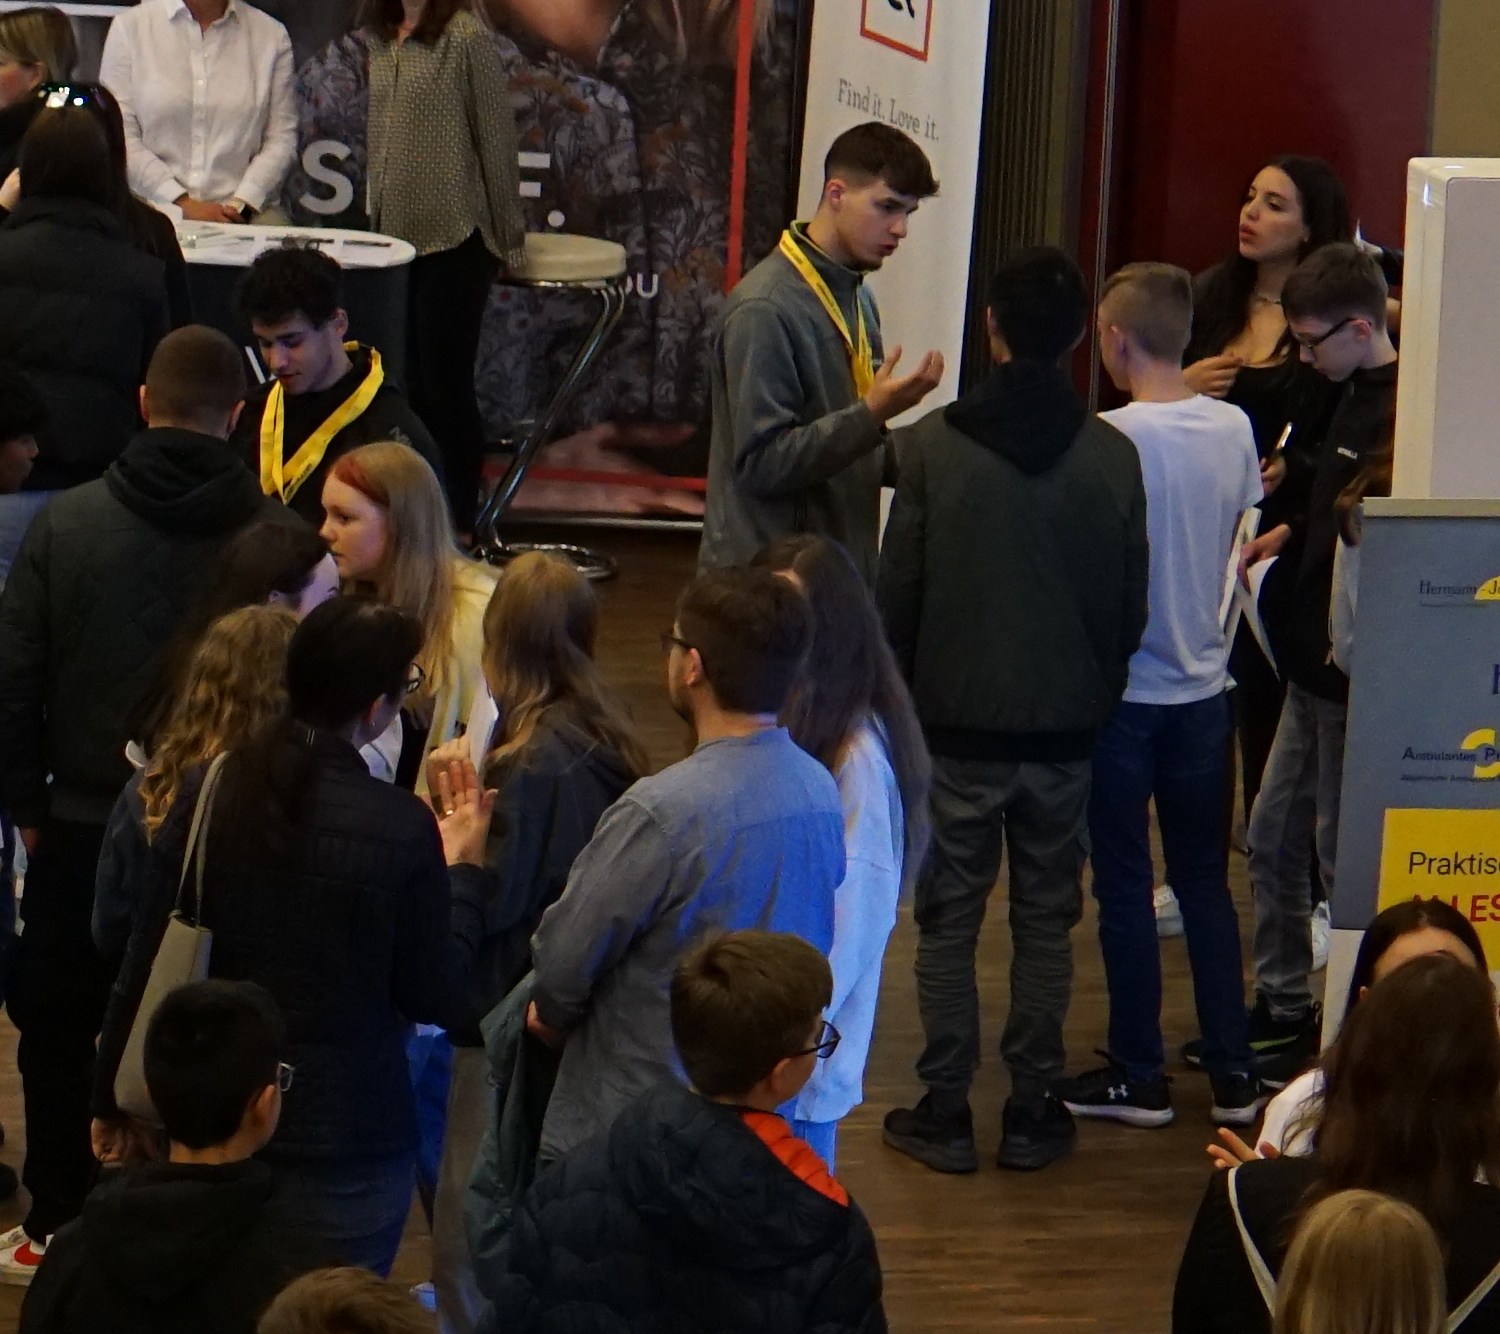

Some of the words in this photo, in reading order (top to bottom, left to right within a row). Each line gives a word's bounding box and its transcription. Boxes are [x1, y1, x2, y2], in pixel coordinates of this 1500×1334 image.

[837, 78, 870, 114] Find
[872, 95, 886, 122] it.
[890, 98, 921, 135] Love
[925, 114, 939, 143] it.
